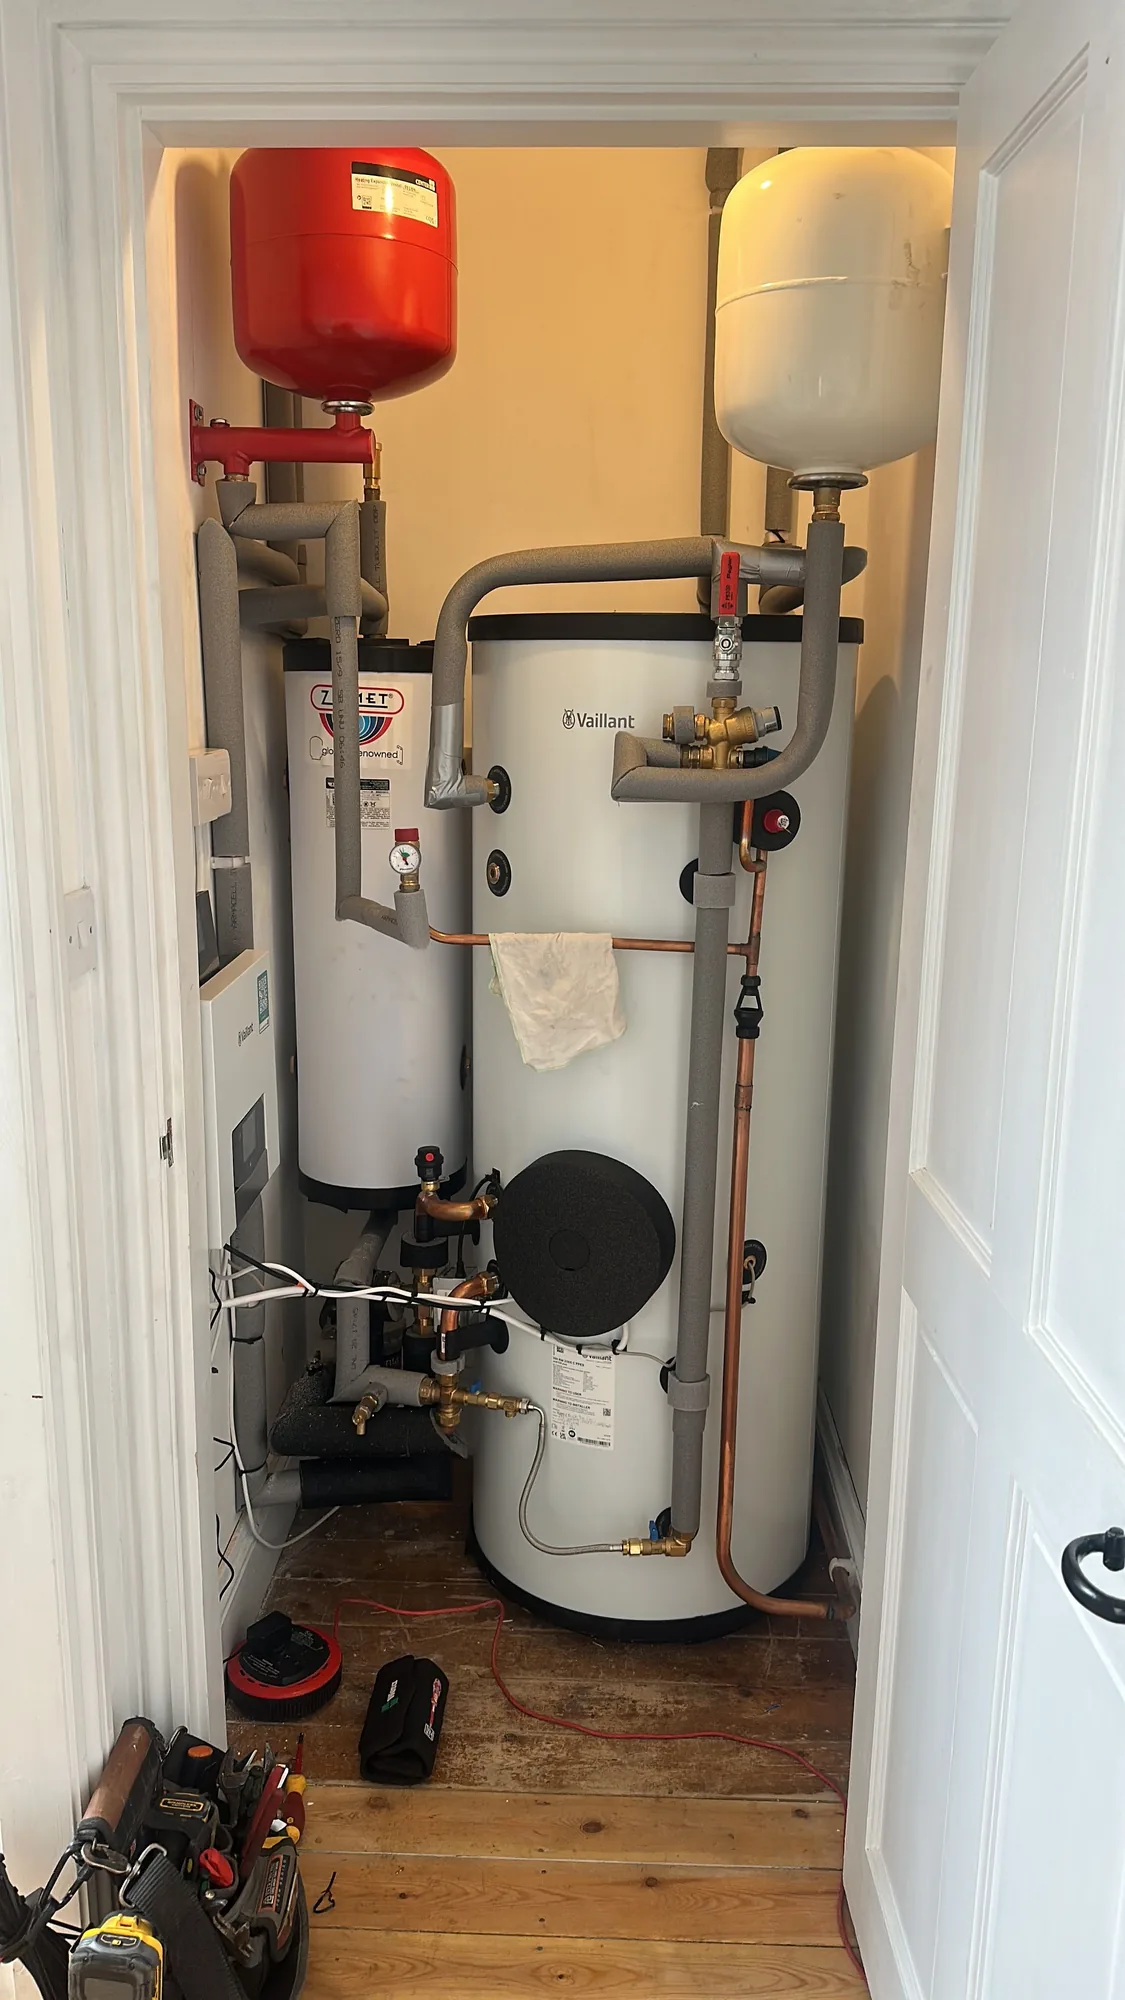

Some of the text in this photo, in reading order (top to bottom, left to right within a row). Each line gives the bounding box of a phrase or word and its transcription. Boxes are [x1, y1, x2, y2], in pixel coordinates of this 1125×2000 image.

[335, 651, 343, 677] 15/9
[577, 713, 635, 729] Vaillant
[360, 750, 398, 759] enowned
